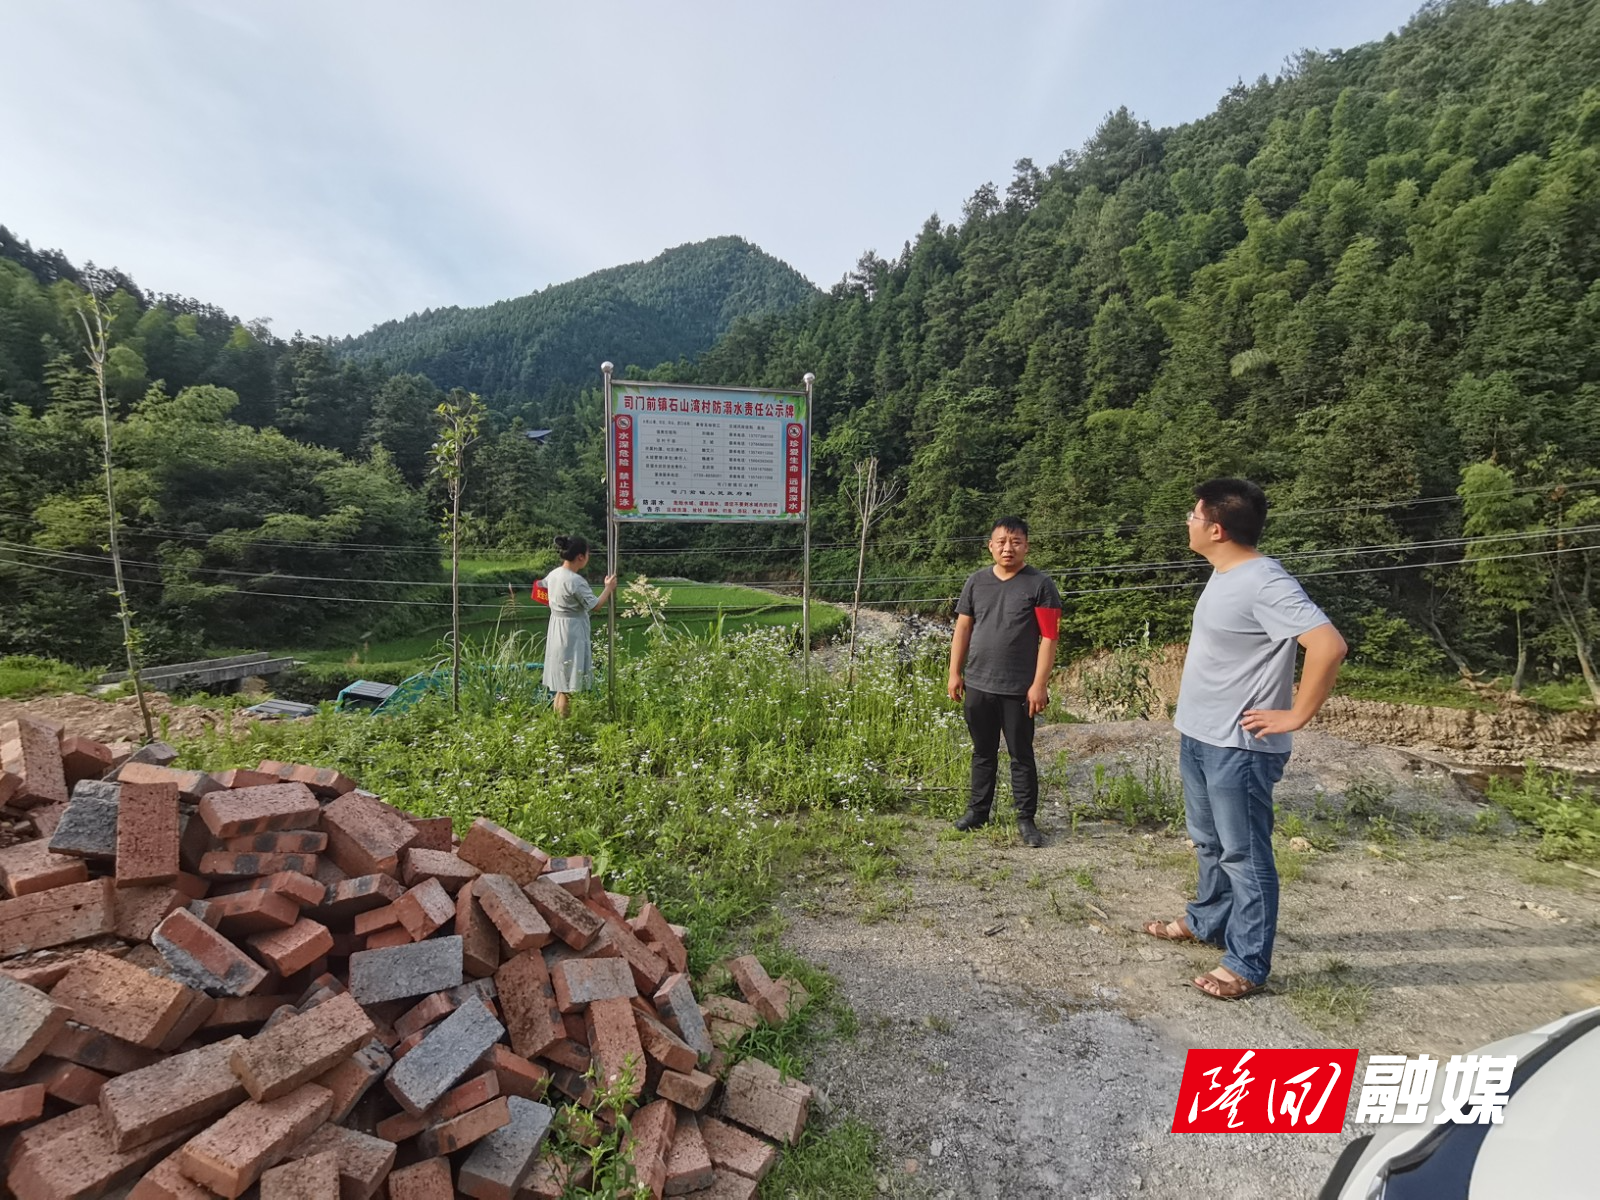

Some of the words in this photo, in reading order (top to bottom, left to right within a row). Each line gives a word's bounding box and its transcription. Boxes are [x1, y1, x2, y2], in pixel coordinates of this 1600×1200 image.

[624, 395, 794, 418] 司门前镇石山湾村防溺水责任公示牌
[618, 432, 630, 466] 水深危险
[789, 440, 799, 472] 珍爱生命
[619, 472, 630, 506] 禁止游泳
[788, 478, 798, 510] 远离深水
